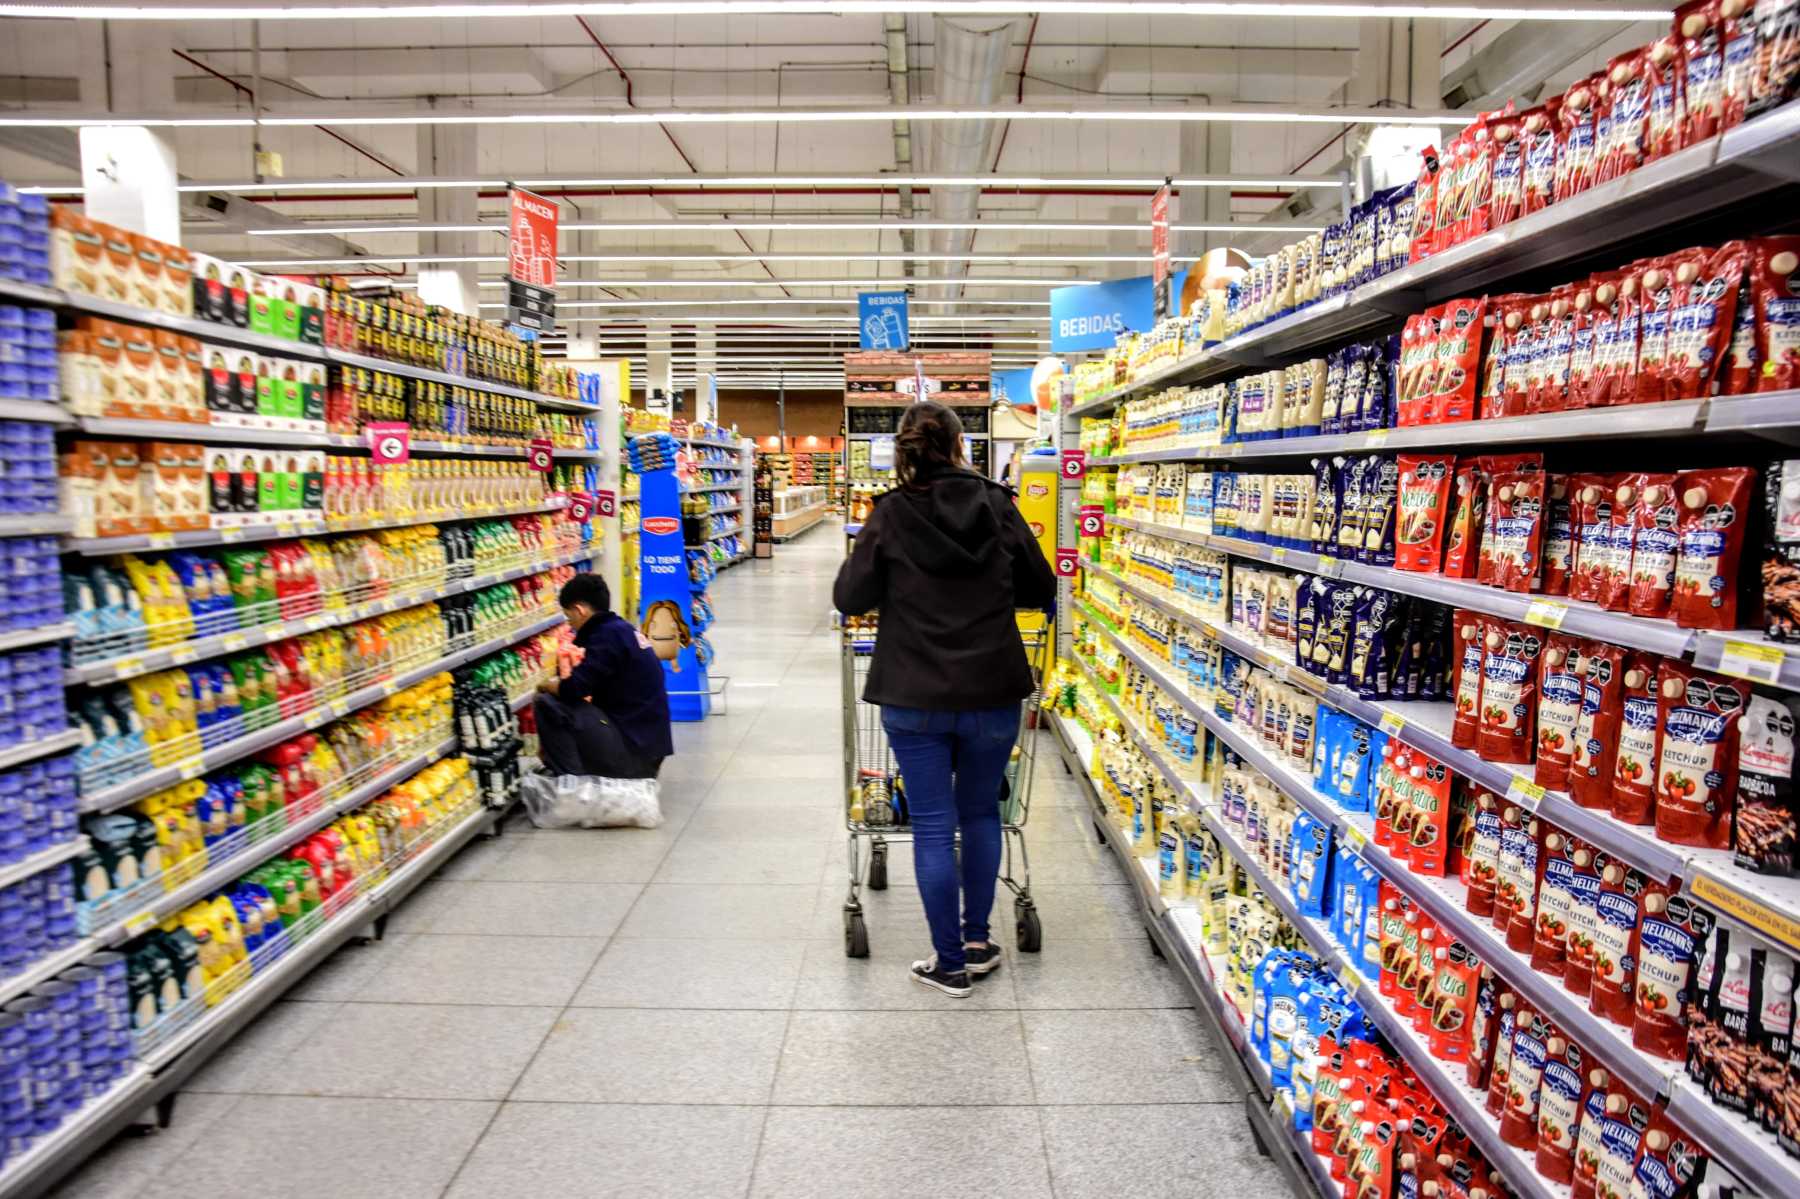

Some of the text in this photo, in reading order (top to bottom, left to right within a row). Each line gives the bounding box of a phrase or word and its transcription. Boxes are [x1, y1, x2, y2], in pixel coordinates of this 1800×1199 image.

[514, 195, 554, 221] ALMACEN
[867, 295, 905, 306] BEBIDAS
[1059, 313, 1122, 337] BEBIDAS
[643, 555, 682, 564] LO TIENE
[650, 565, 676, 574] TODO
[1540, 709, 1574, 724] KETCHUP
[1663, 749, 1708, 767] KETCHUP
[1541, 892, 1570, 910] KETCHU
[1642, 921, 1694, 954] HELLMANN'S
[1274, 1000, 1297, 1016] HEINZ
[1545, 1062, 1582, 1094] HELLMANN'S
